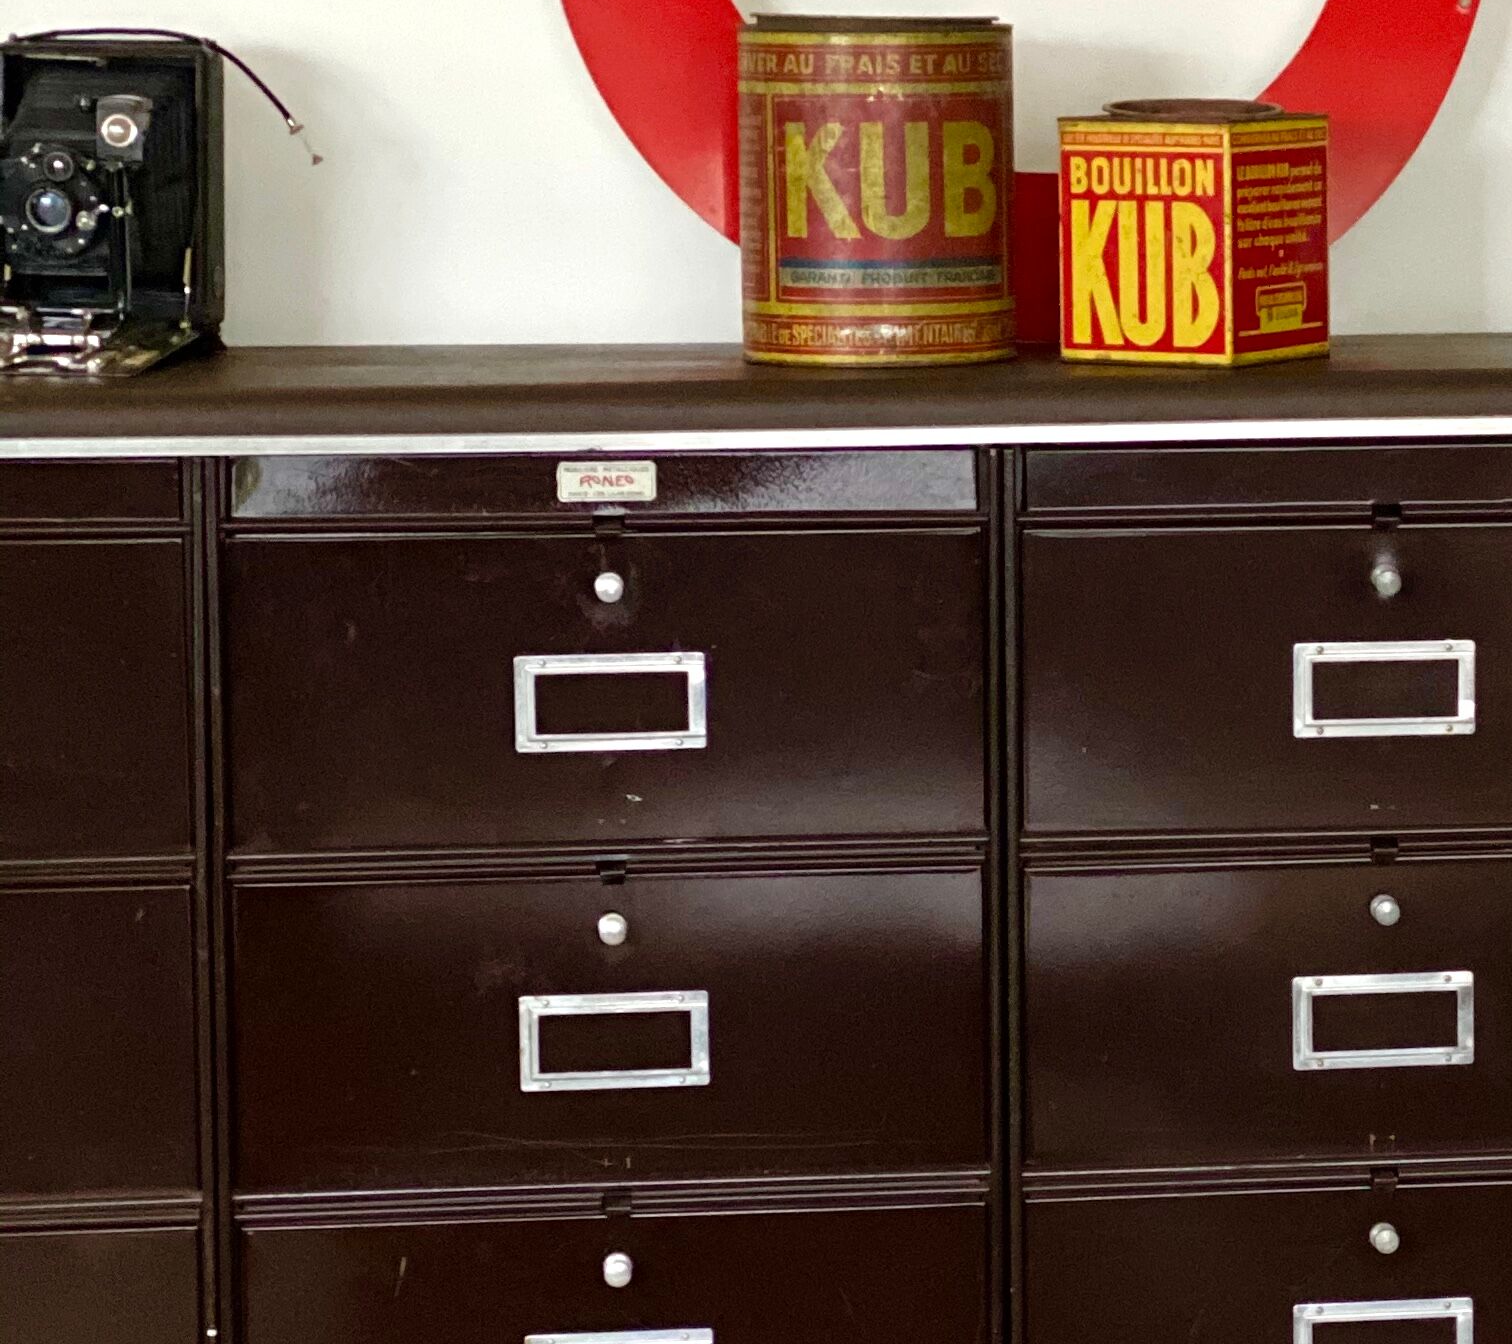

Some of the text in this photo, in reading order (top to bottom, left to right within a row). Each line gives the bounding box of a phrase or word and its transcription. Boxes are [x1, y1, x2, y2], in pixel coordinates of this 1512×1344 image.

[783, 53, 814, 74] AU
[825, 53, 901, 76] FRAIS
[909, 53, 935, 74] ET
[942, 53, 971, 74] AU
[784, 120, 998, 240] KUB
[1069, 156, 1215, 197] BOUILLON
[1071, 199, 1220, 348] KUB
[579, 474, 635, 488] RONEO
